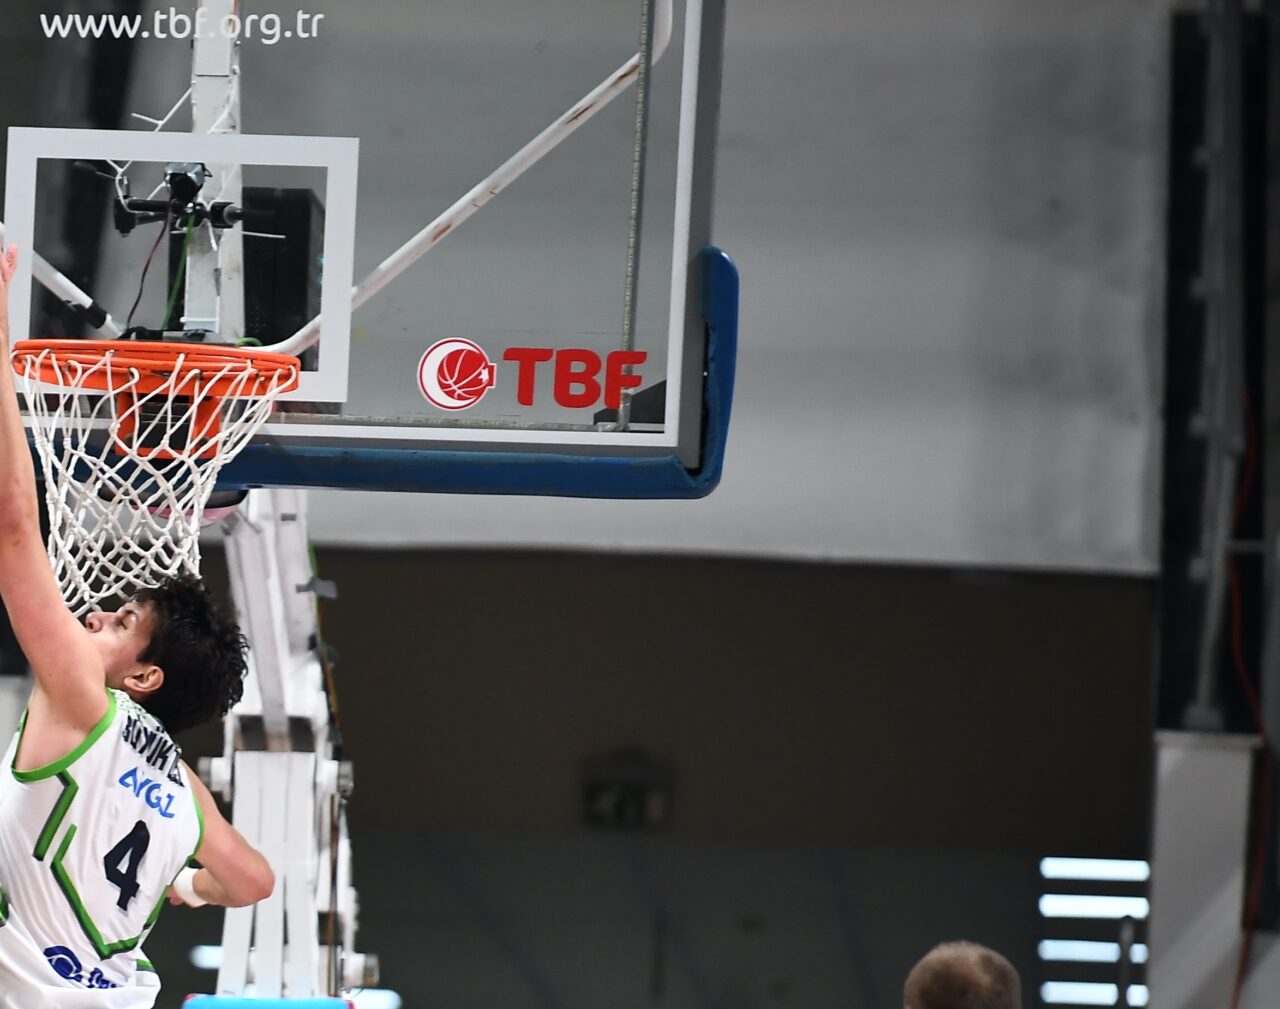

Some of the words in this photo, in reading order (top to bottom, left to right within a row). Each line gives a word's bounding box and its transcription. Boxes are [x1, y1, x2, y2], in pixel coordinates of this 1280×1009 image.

[40, 7, 325, 45] www.tbf.org.tr
[502, 347, 648, 410] TBF
[103, 820, 151, 911] 4
